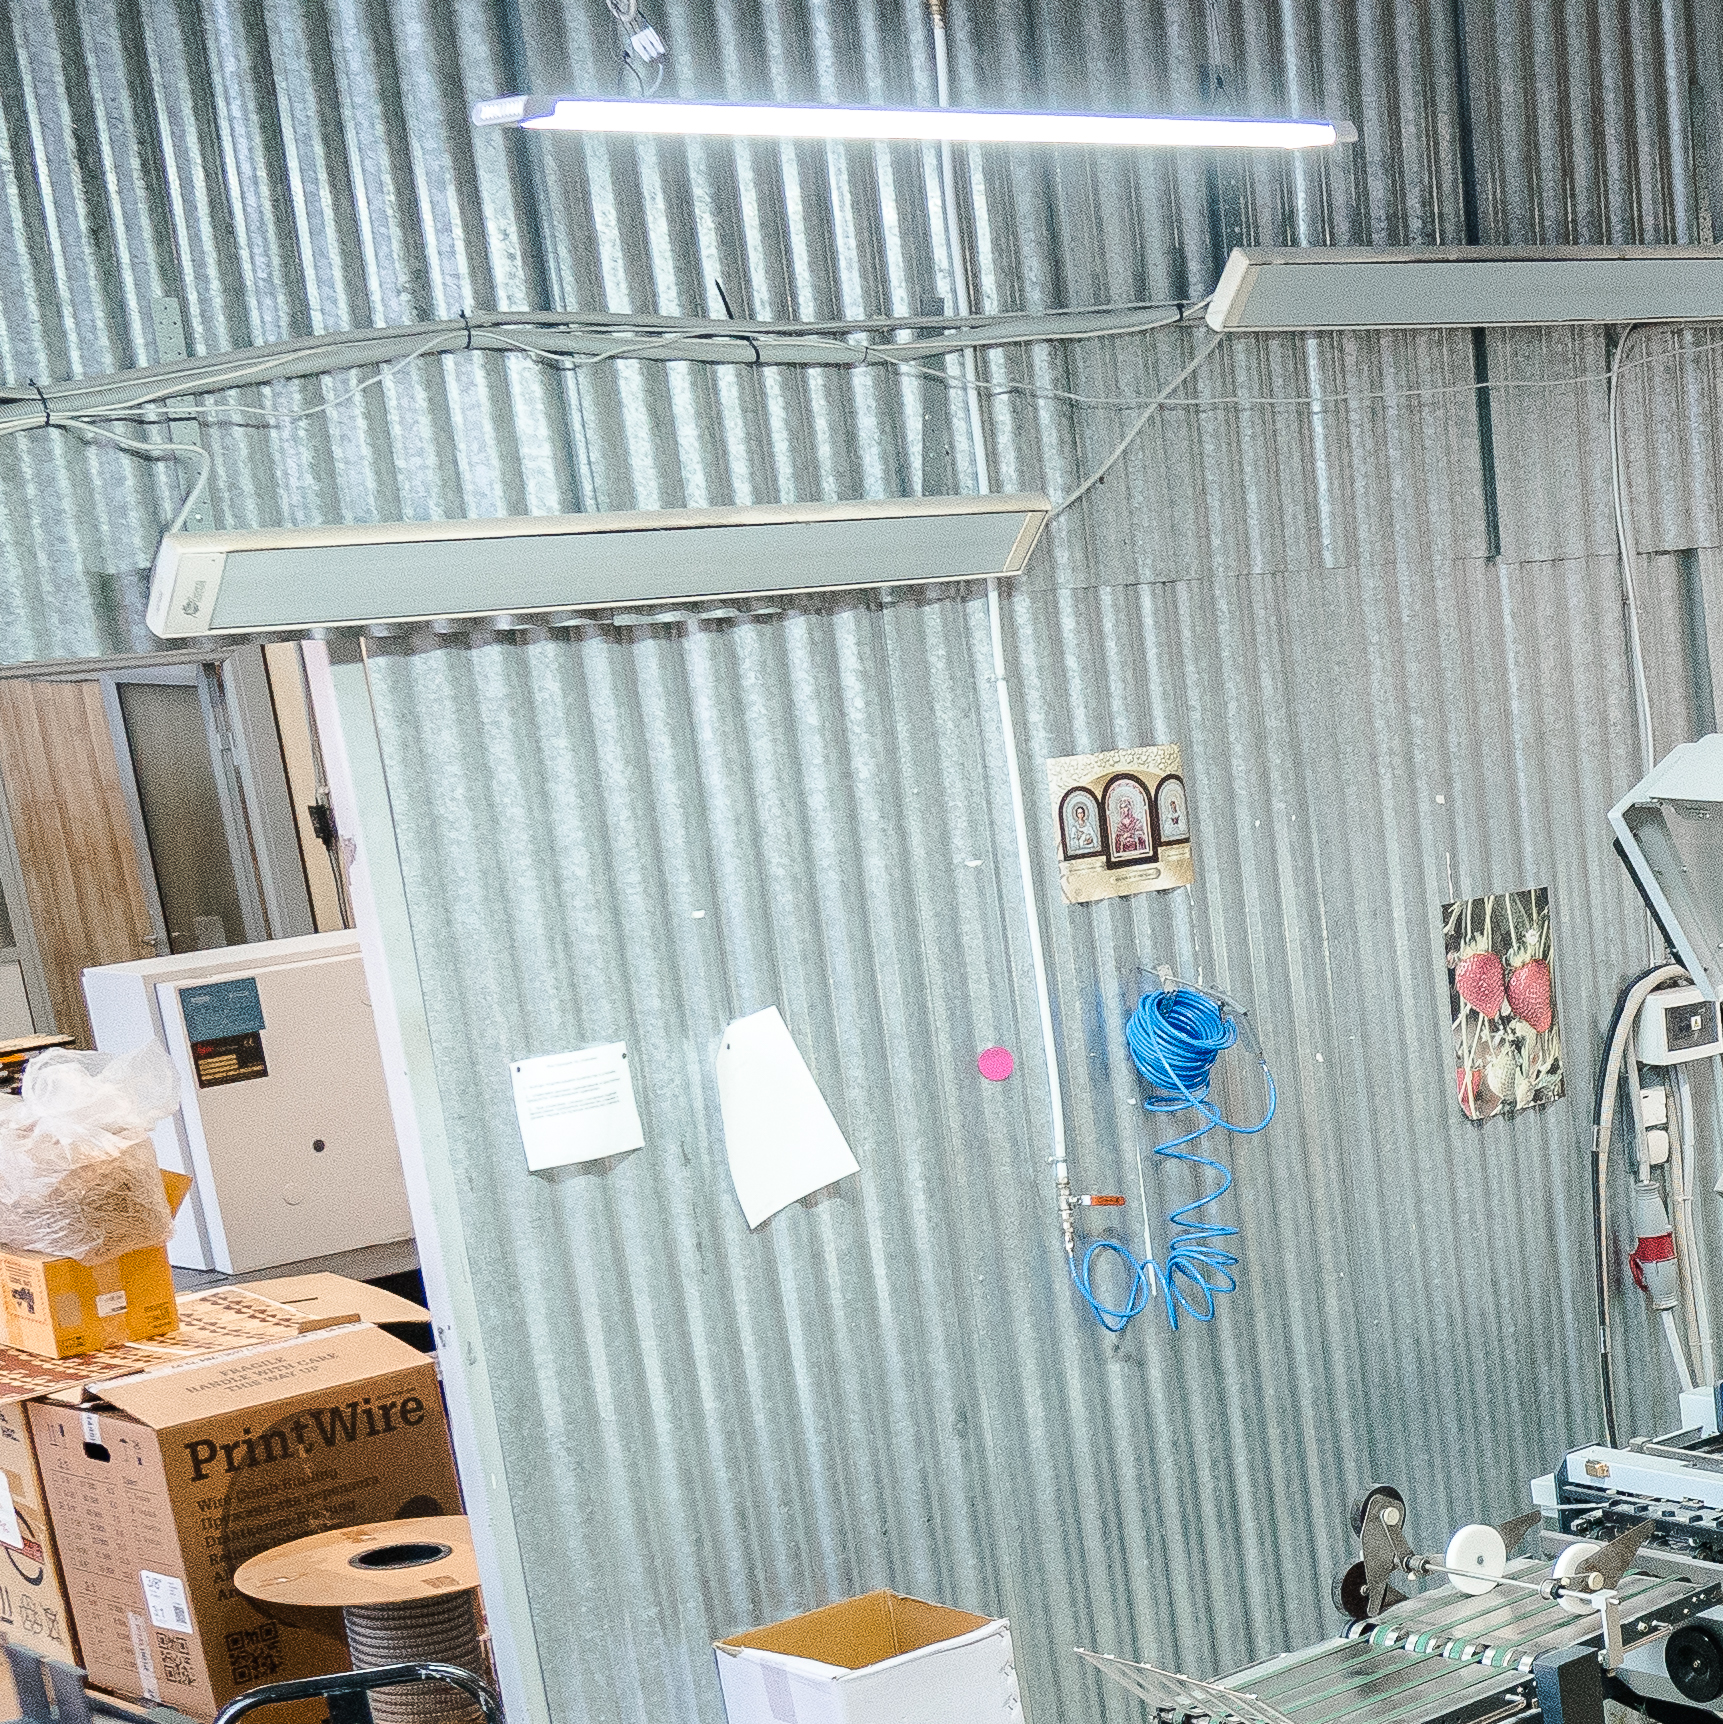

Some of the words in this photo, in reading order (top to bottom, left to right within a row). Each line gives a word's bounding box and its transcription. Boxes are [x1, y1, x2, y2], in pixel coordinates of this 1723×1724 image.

[185, 1374, 252, 1394] HANDLE
[252, 1361, 297, 1378] WITH
[296, 1352, 340, 1368] CARE
[219, 1356, 286, 1377] FRAGILE
[223, 1379, 263, 1393] THIS
[262, 1369, 298, 1383] WAY
[297, 1364, 320, 1377] UP
[184, 1396, 424, 1482] PrintWire
